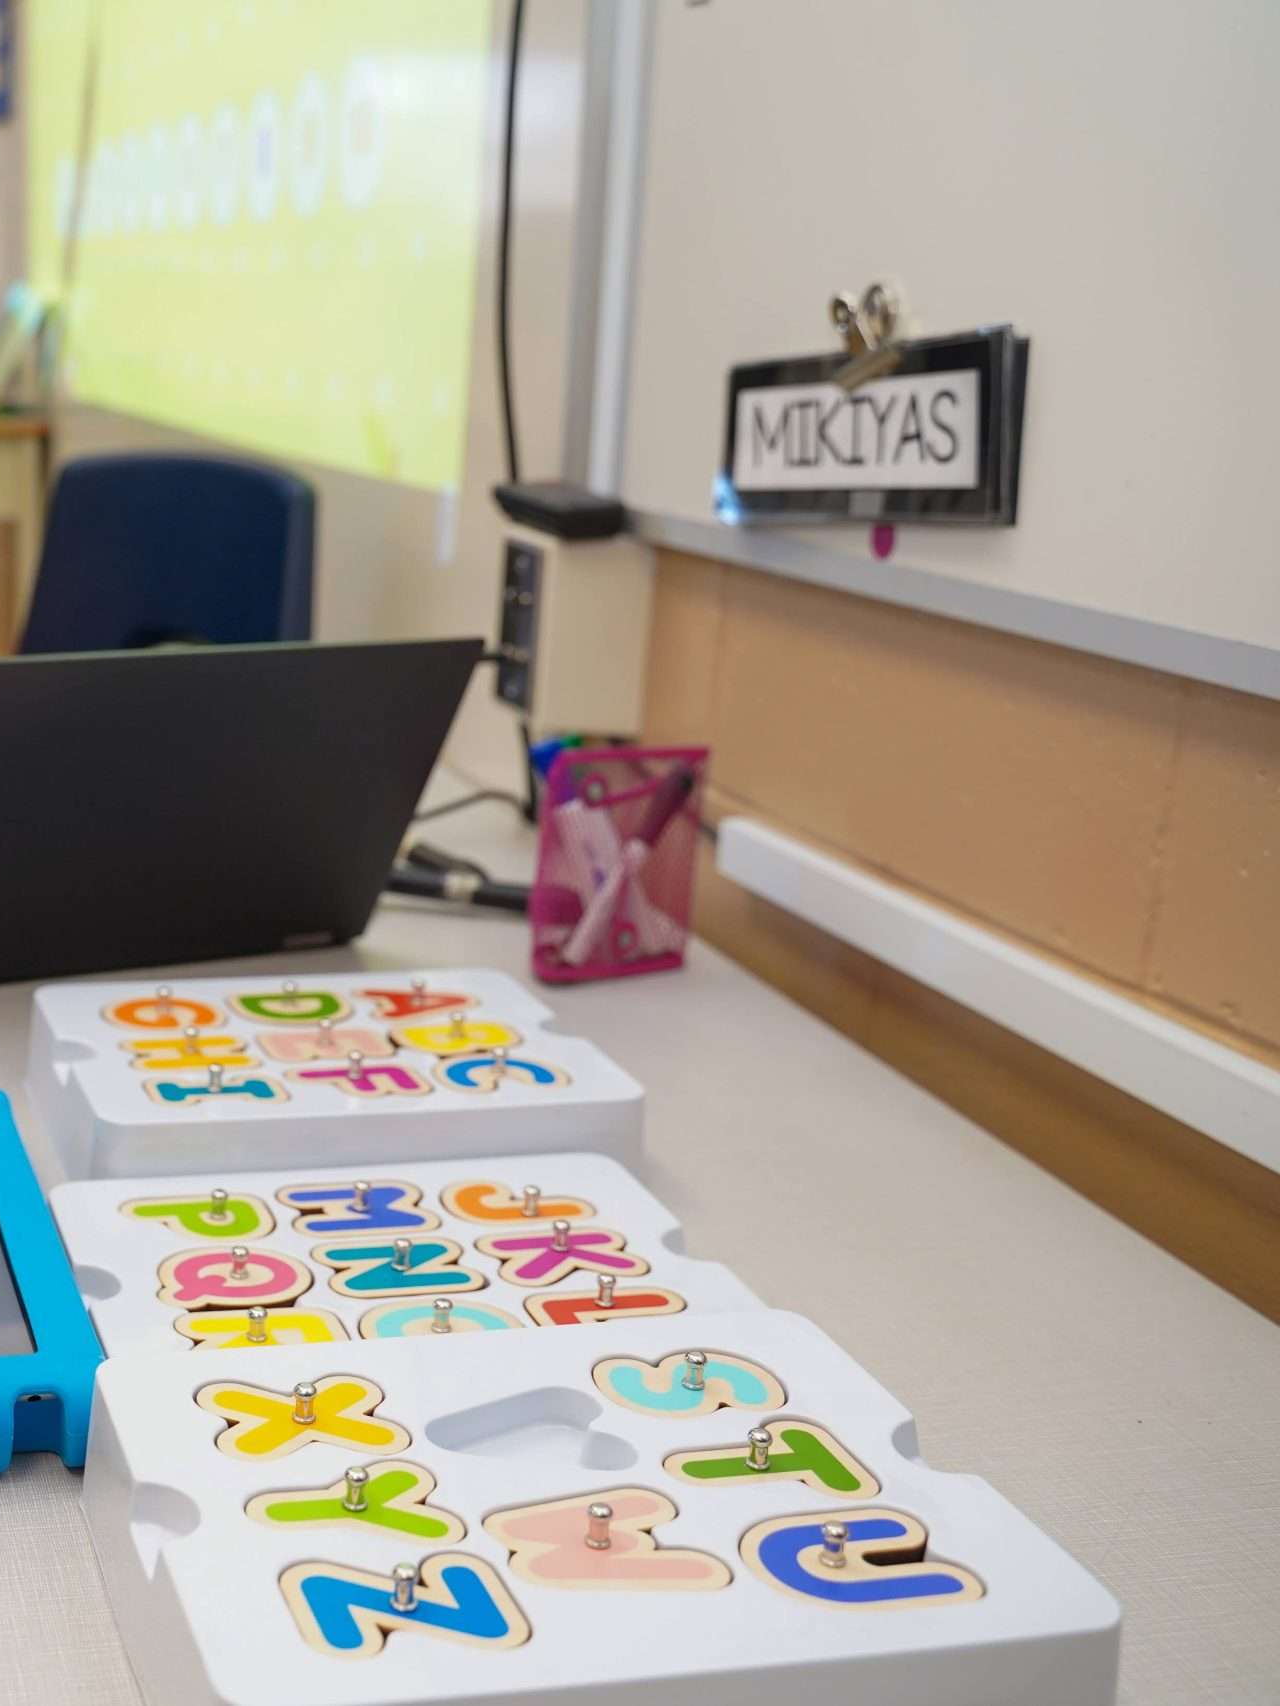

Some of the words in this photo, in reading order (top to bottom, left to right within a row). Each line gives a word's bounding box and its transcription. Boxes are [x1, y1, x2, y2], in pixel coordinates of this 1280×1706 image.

[752, 390, 959, 467] MIKIYAS
[115, 999, 216, 1028] G
[359, 990, 470, 1018] A
[132, 1036, 251, 1070] H
[241, 993, 339, 1019] D
[300, 1067, 418, 1092] F
[404, 1022, 510, 1051] B
[158, 1080, 273, 1101] I
[447, 1059, 554, 1086] C
[134, 1200, 260, 1238] P
[288, 1186, 425, 1232] M
[454, 1184, 582, 1220] J
[174, 1253, 296, 1300] Q
[327, 1244, 470, 1290] N
[494, 1234, 633, 1279] K
[610, 1362, 768, 1410] S
[214, 1383, 394, 1454] X
[683, 1430, 860, 1491] T
[265, 1471, 448, 1538] Y
[502, 1497, 713, 1581] W
[760, 1520, 962, 1602] U
[301, 1567, 508, 1649] Z
